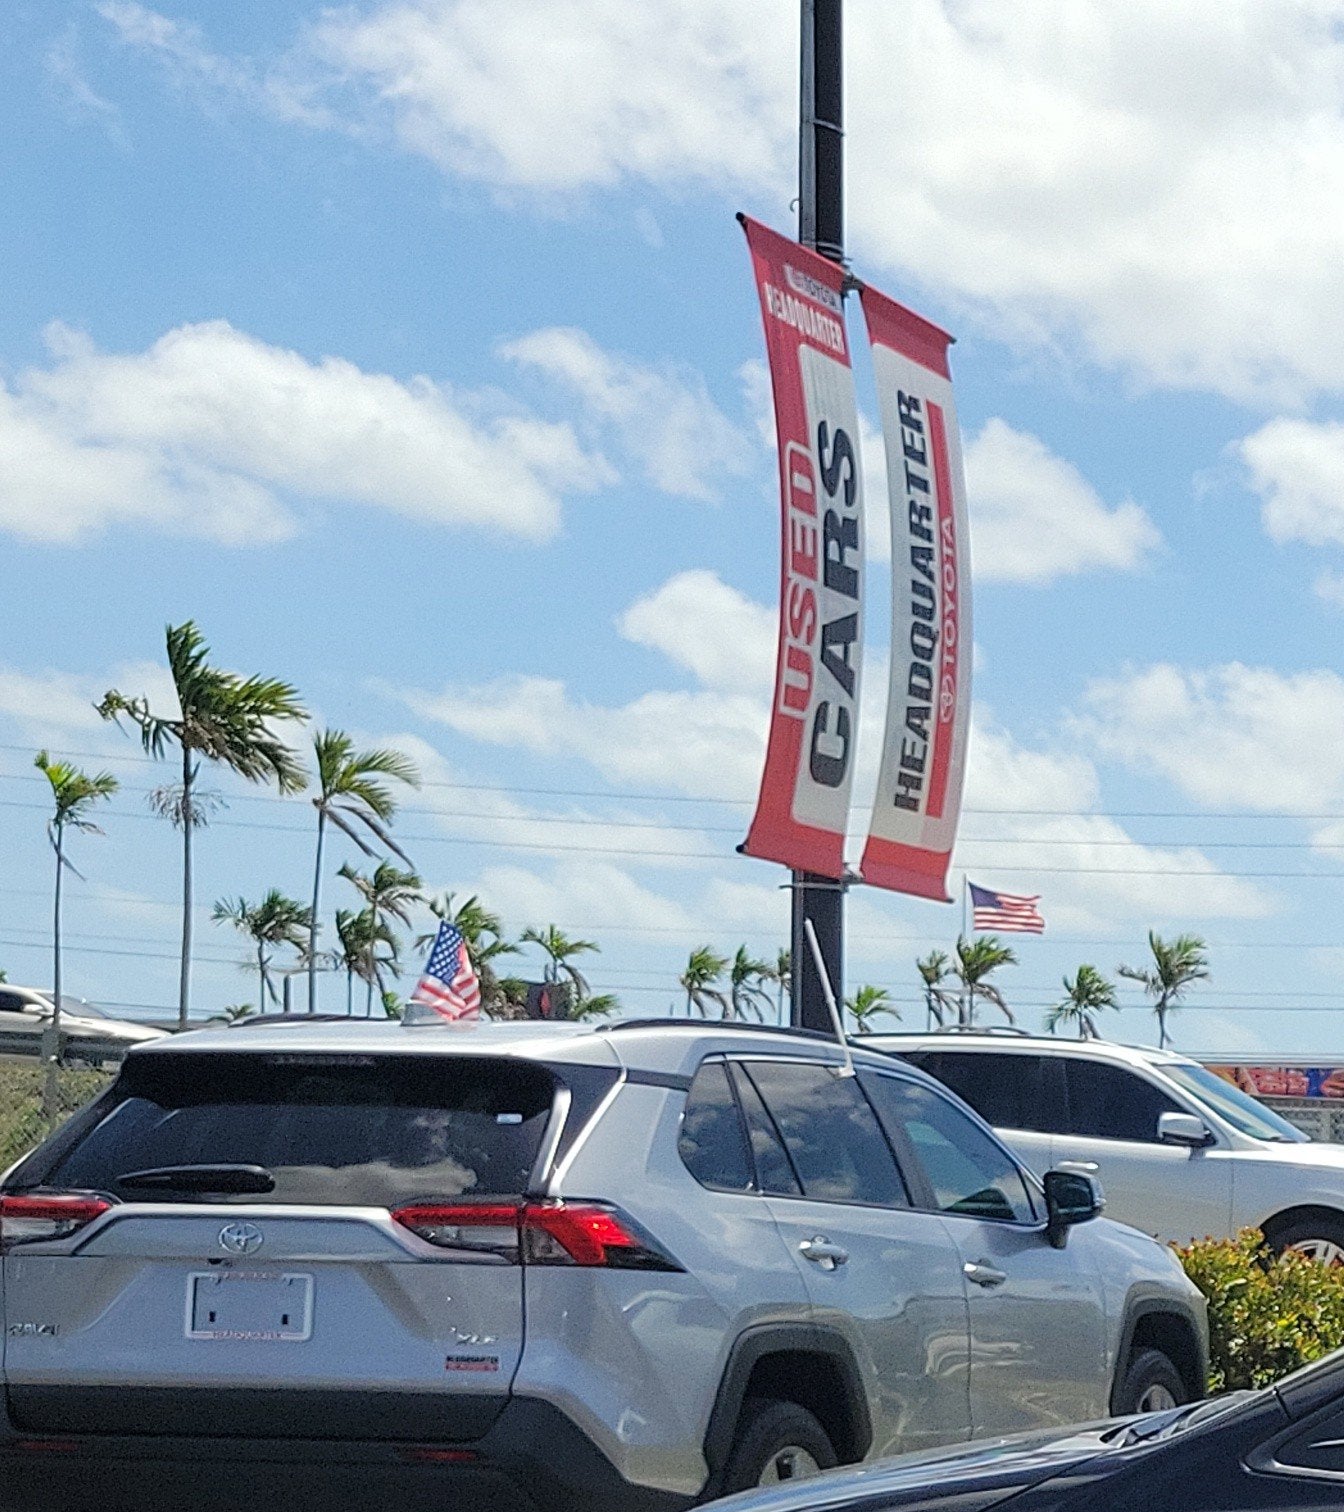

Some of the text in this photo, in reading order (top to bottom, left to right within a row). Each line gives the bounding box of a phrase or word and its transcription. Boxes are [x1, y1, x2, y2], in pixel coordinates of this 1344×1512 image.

[779, 439, 818, 721] USED
[810, 420, 859, 788] CARS
[894, 389, 939, 812] HEADQUARTER
[940, 516, 957, 664] TOYOTA
